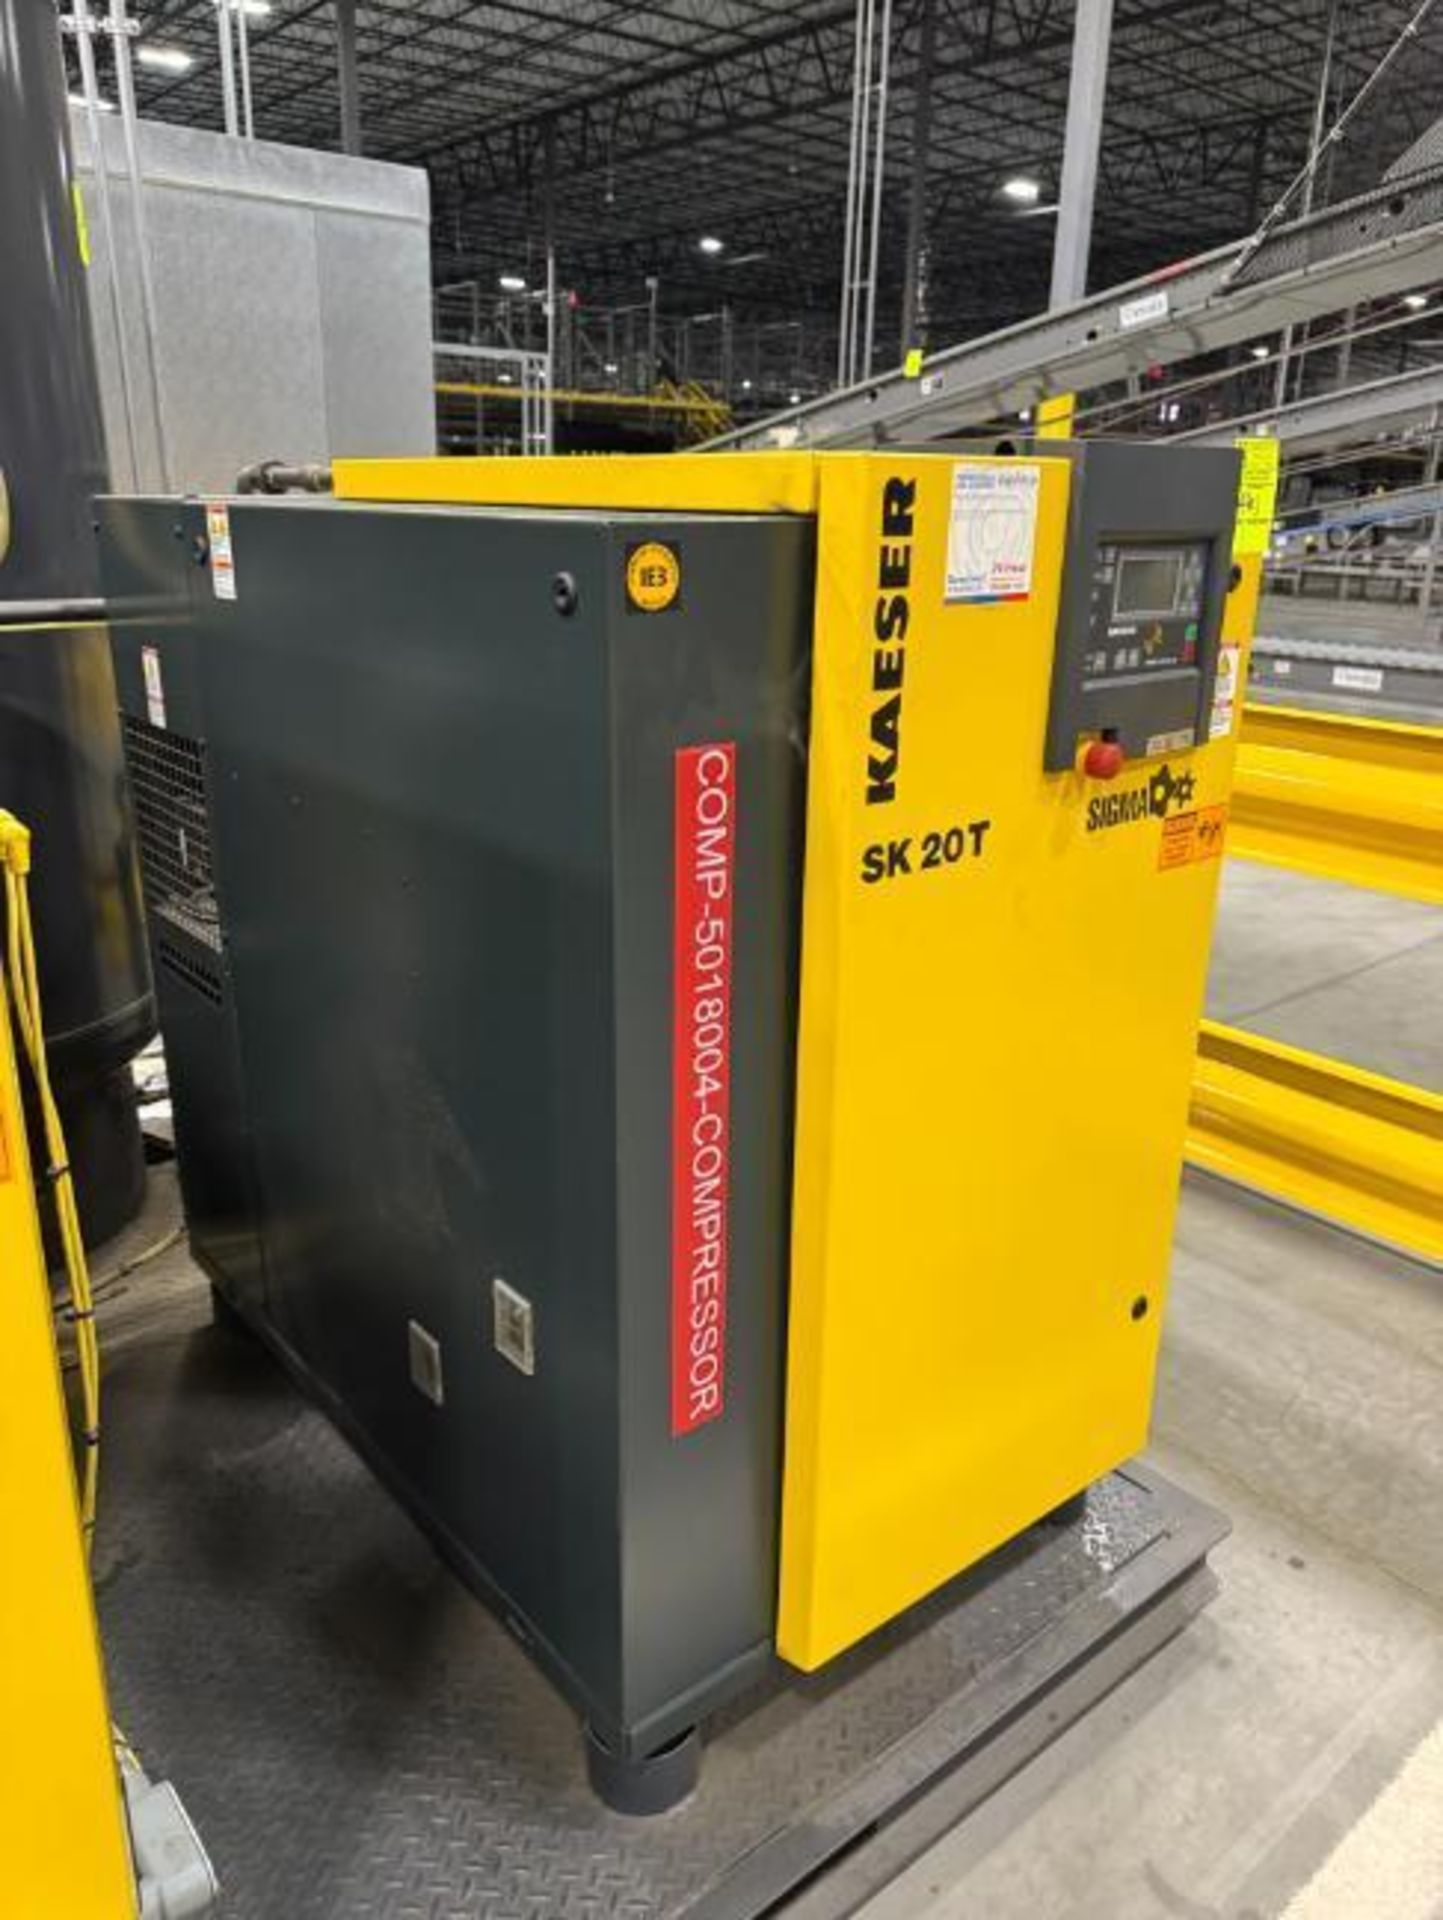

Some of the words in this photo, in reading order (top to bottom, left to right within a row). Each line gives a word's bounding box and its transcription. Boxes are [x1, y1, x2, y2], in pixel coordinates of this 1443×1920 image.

[639, 565, 668, 588] IE3
[866, 476, 917, 806] KAESER
[1087, 787, 1148, 832] SIGMA
[861, 837, 914, 884] SK
[688, 749, 731, 1420] COMP-5018004-COMPRESSOR
